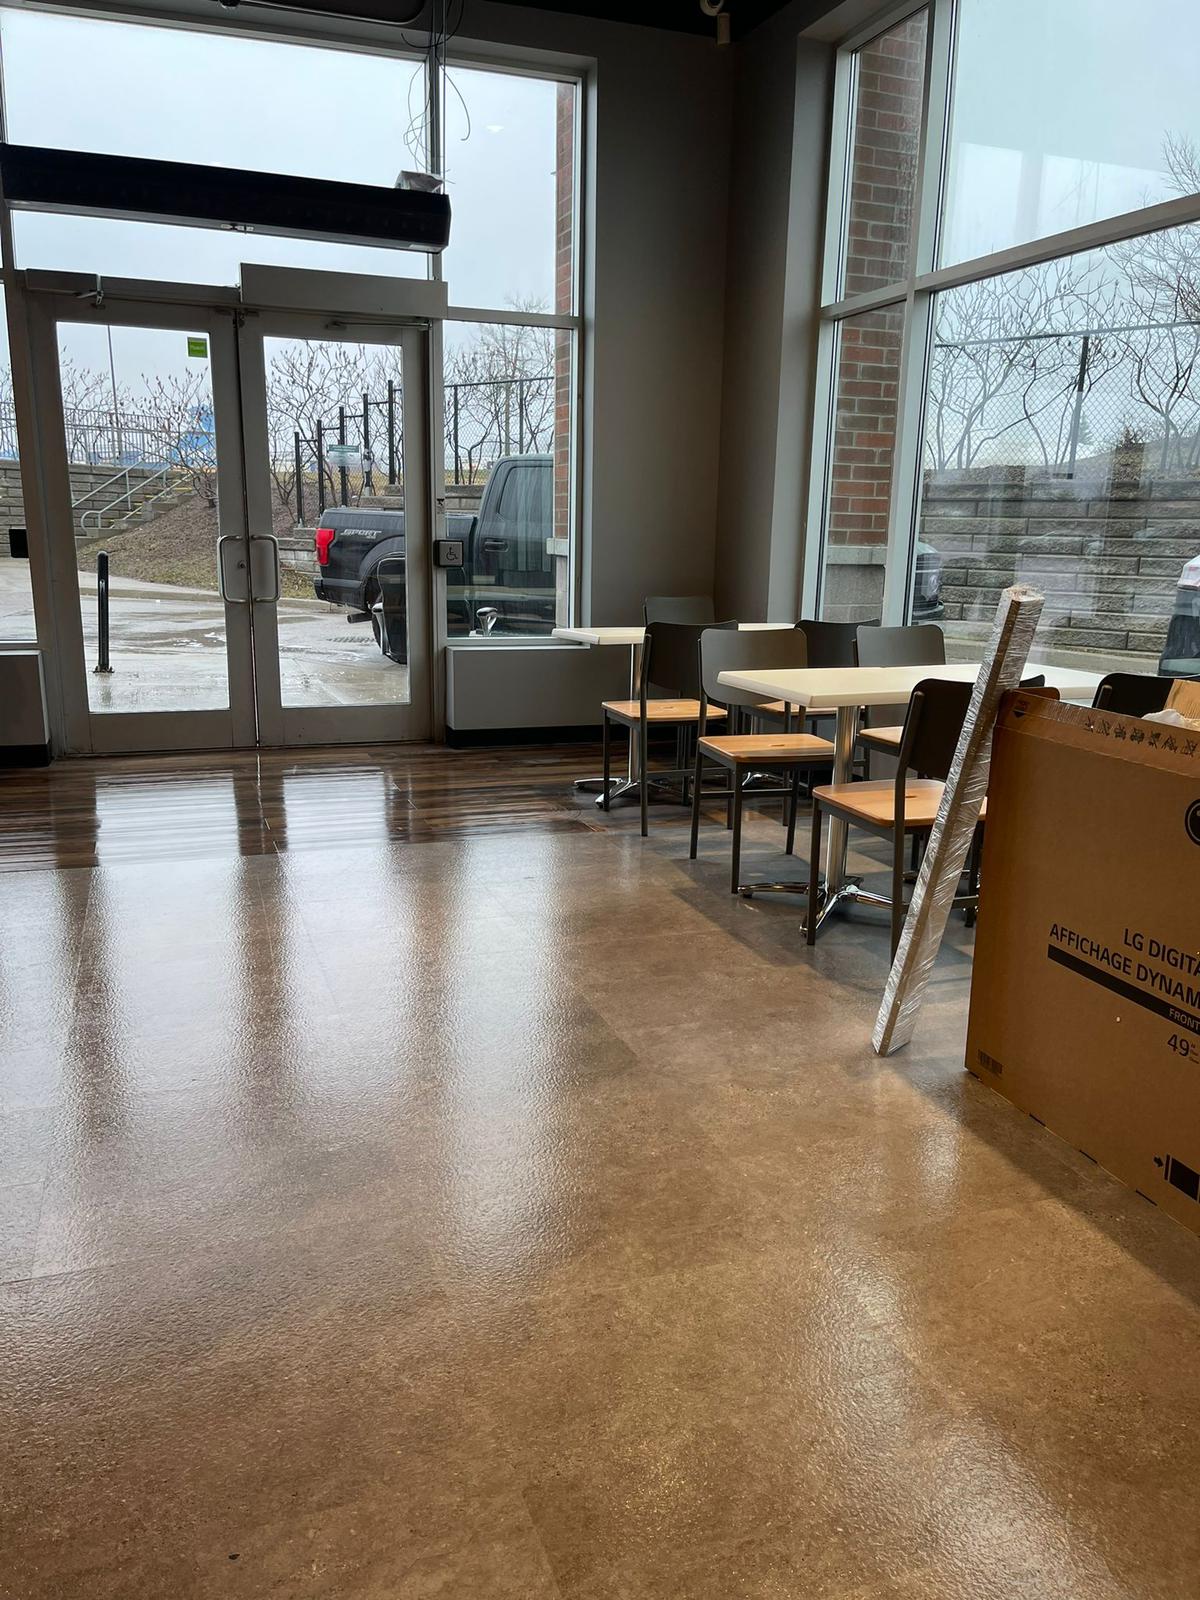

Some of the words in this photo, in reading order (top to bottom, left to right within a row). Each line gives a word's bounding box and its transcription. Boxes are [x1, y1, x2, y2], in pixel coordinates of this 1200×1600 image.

[340, 528, 382, 537] SPORT
[1123, 928, 1144, 952] LG
[1049, 923, 1133, 976] AFFICHAGE
[1136, 963, 1200, 1010] DYNAM
[1169, 1008, 1200, 1031] FRONT
